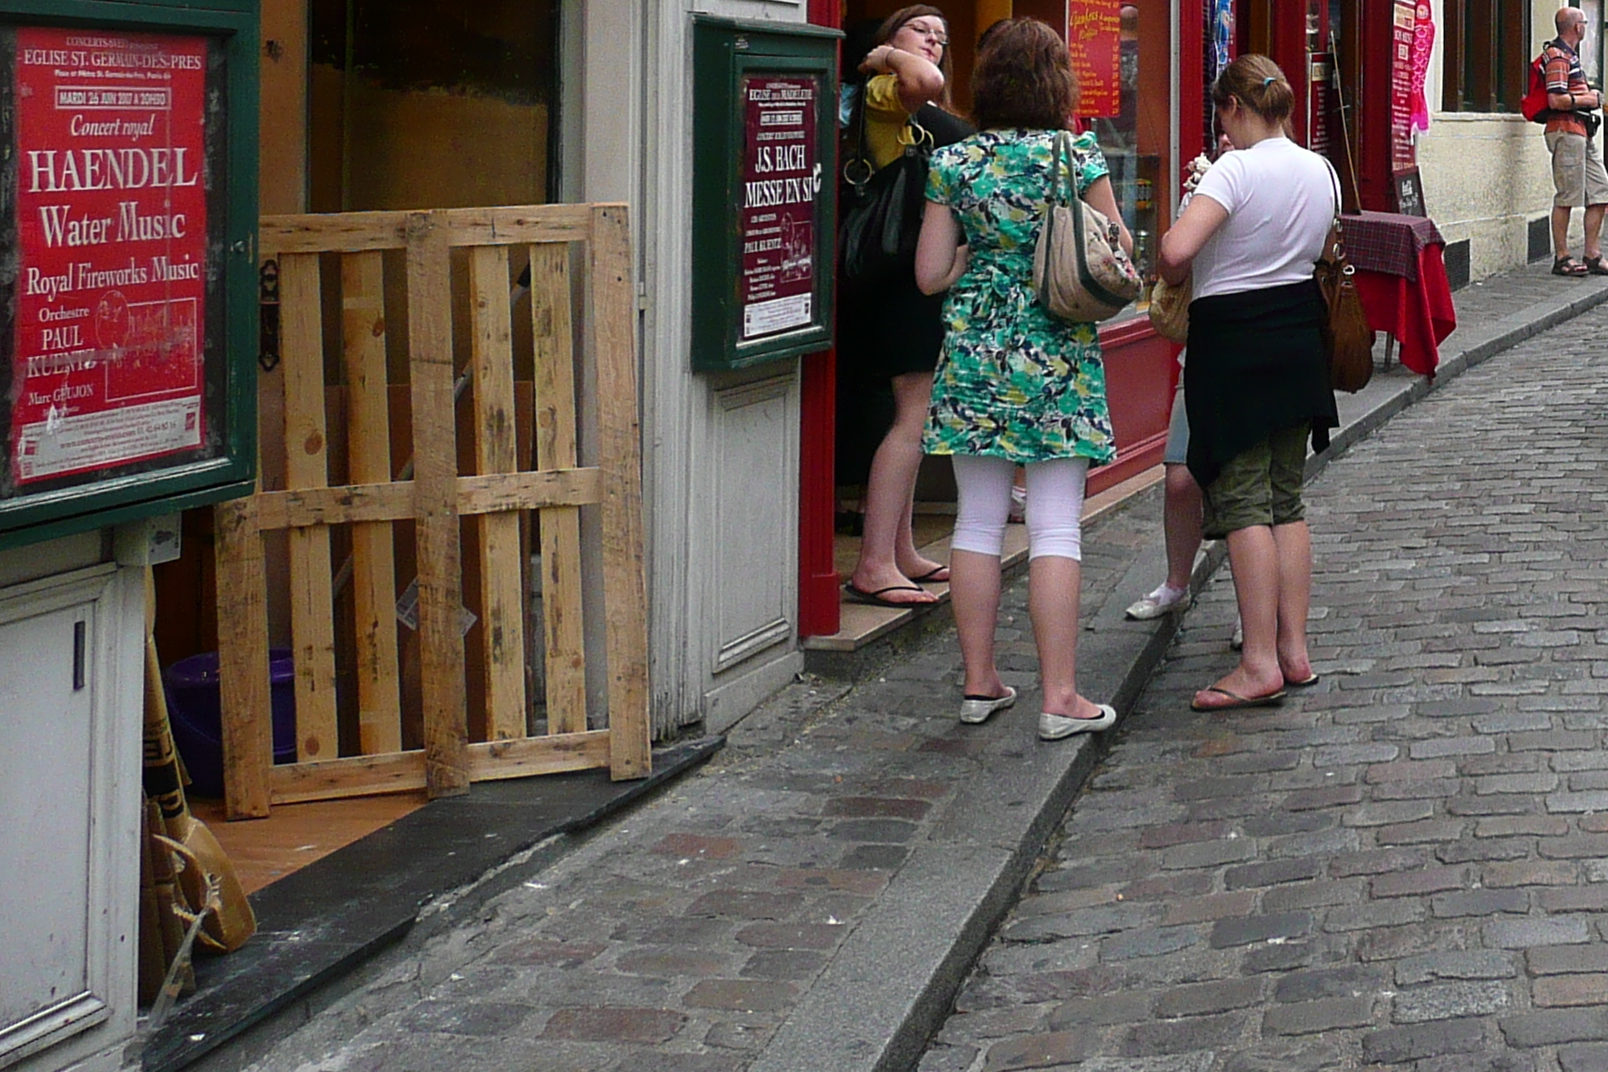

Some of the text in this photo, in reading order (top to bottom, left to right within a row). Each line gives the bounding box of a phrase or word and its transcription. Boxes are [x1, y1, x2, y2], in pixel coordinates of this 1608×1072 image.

[23, 49, 69, 67] EGLISE
[59, 91, 87, 105] MARDI
[71, 113, 156, 142] Concert royal
[27, 147, 198, 193] HAENDEL
[755, 144, 806, 173] J.S. BACH
[744, 176, 813, 208] MESSE EN SI
[39, 199, 186, 248] Water Music
[26, 253, 199, 302] Royal Fireworks Music
[39, 304, 90, 322] Orchestre
[41, 325, 84, 351] PAUL
